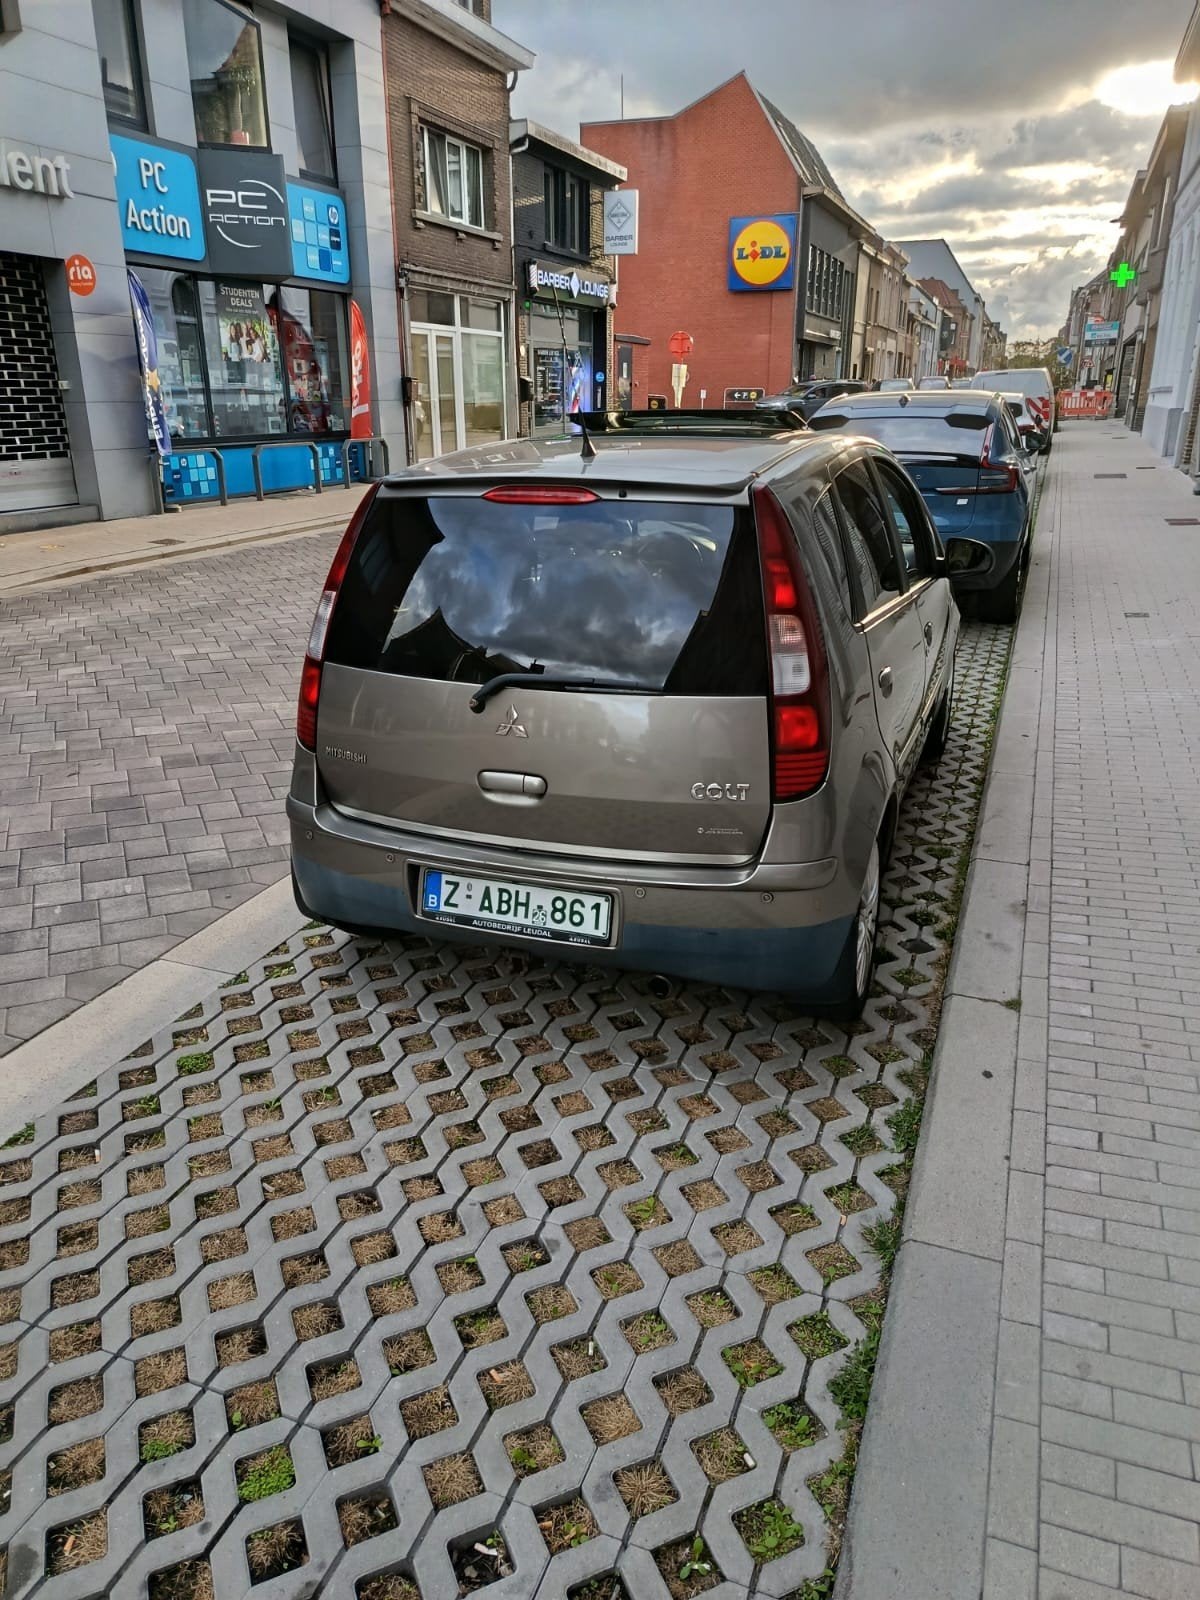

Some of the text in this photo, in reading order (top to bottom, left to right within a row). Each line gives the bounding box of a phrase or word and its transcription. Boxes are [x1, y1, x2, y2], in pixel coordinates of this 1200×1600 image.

[138, 158, 169, 193] PC
[205, 188, 268, 210] PC
[126, 198, 191, 240] Action
[605, 234, 633, 242] BARBER
[69, 259, 93, 280] ria
[220, 286, 260, 299] STUDENTEN
[537, 269, 609, 298] BARBER LOUNGE
[230, 297, 253, 307] DEALS
[325, 746, 368, 764] MITSUBISHI
[690, 782, 750, 801] COLT
[428, 894, 438, 907] B
[472, 919, 552, 938] AUTOBEDRIJF LEUDAL
